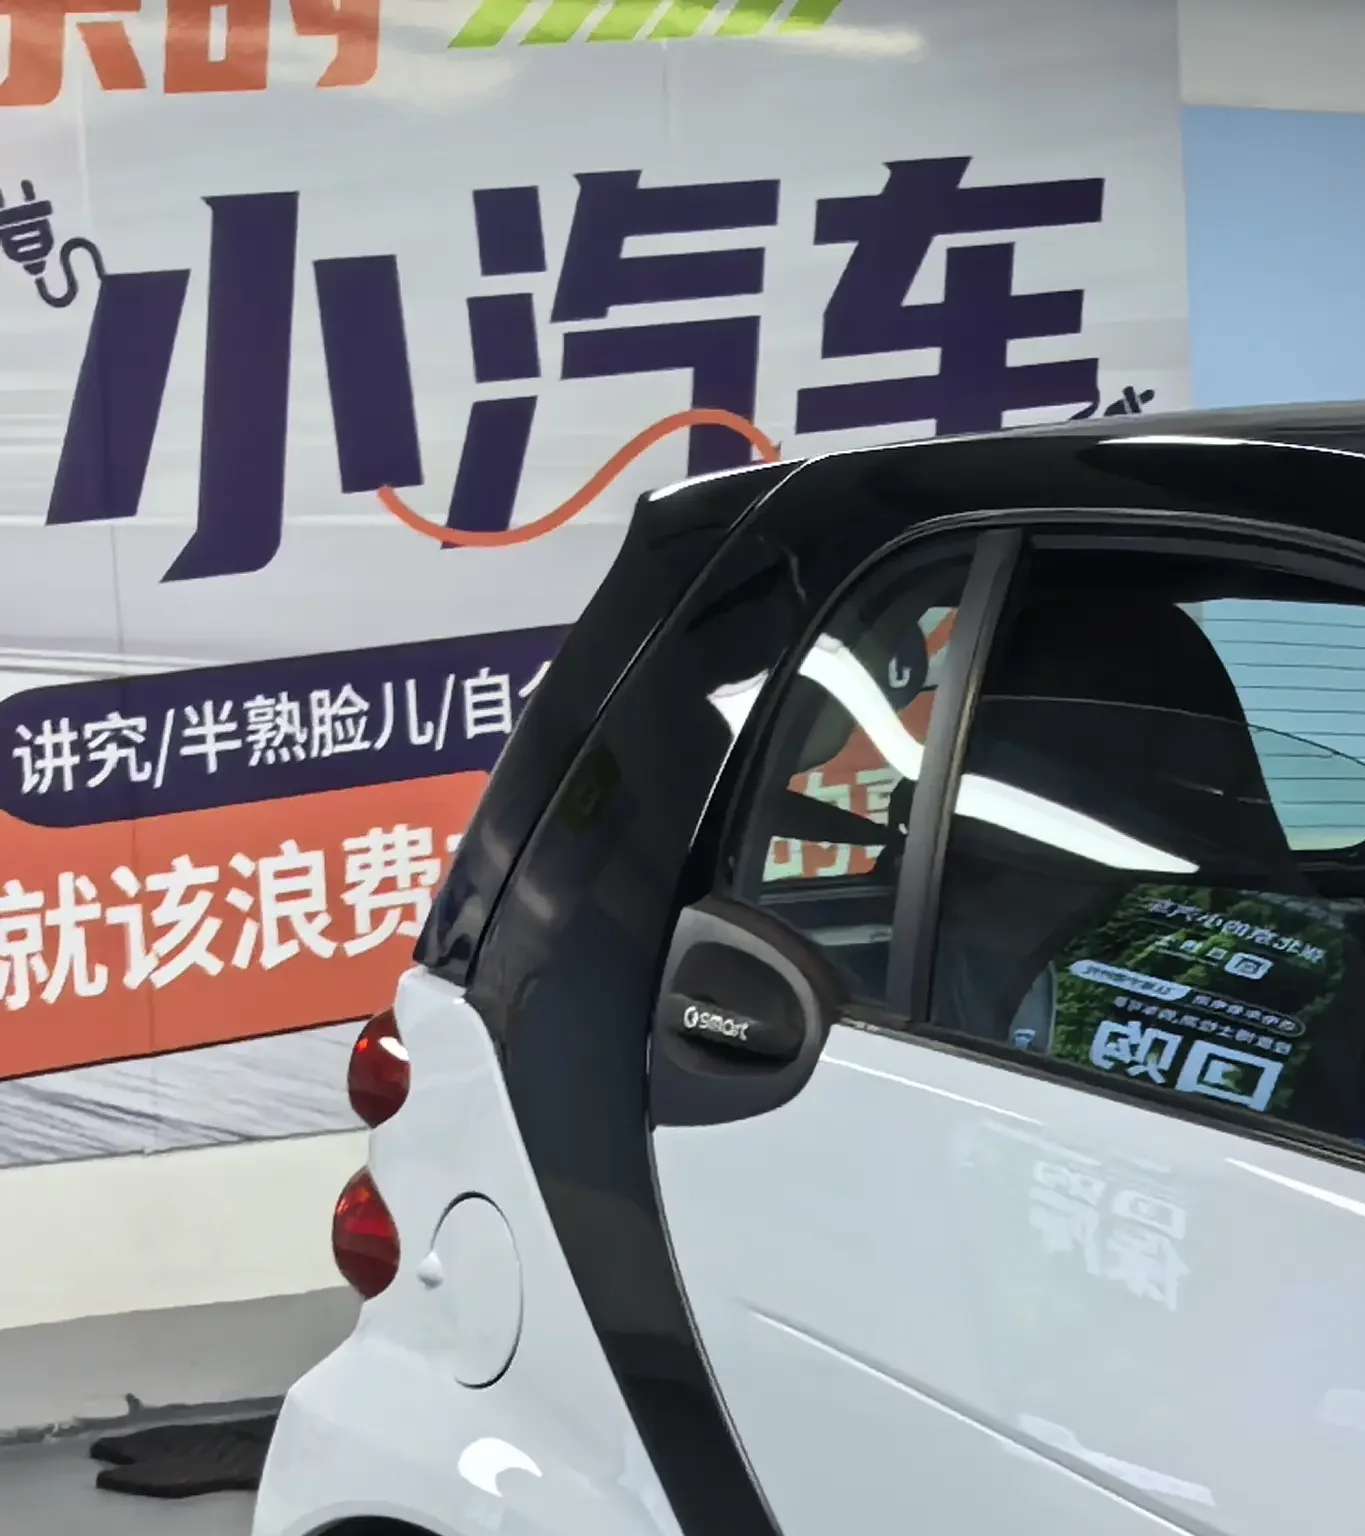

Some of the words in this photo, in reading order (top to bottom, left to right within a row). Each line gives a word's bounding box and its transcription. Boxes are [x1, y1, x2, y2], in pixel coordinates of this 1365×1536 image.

[46, 155, 1106, 583] 小汽车
[12, 660, 552, 796] 讲究/半熟脸儿/自
[0, 822, 464, 1012] 就该浪费
[699, 1013, 750, 1041] smart
